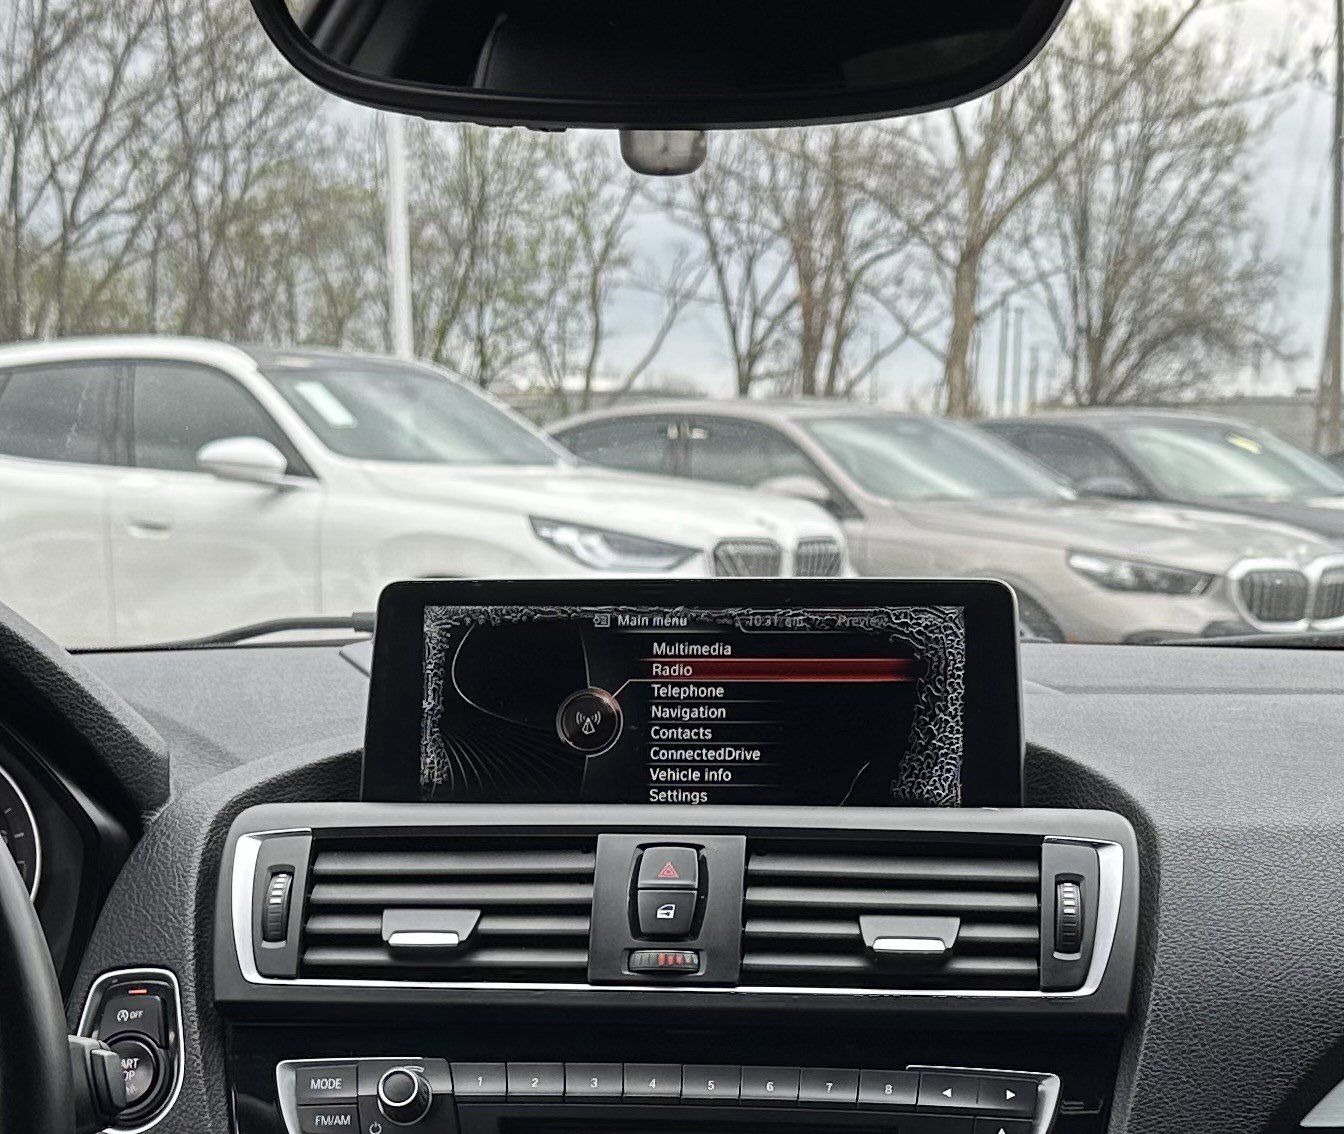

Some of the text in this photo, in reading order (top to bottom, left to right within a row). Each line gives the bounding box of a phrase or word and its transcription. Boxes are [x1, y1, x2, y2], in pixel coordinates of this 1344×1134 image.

[617, 614, 688, 628] Main menu
[652, 641, 732, 656] Multimedia
[652, 663, 693, 676] Radio
[651, 684, 725, 700] Telephone
[651, 704, 726, 721] Navigation
[650, 726, 712, 740] Contacts
[650, 746, 761, 761] ConnectedDrive
[649, 767, 732, 782] Vehicle info
[649, 788, 708, 805] Settings
[129, 1010, 144, 1019] OFF
[121, 1058, 139, 1069] ART
[310, 1078, 343, 1090] MODE
[477, 1077, 484, 1087] 1
[531, 1077, 539, 1088] 2
[590, 1078, 598, 1088] 3
[648, 1078, 657, 1089] 4
[706, 1080, 716, 1091] 5
[766, 1081, 775, 1093] 6
[825, 1082, 834, 1094] 7
[884, 1084, 893, 1095] 8
[314, 1115, 351, 1127] FM/AM
